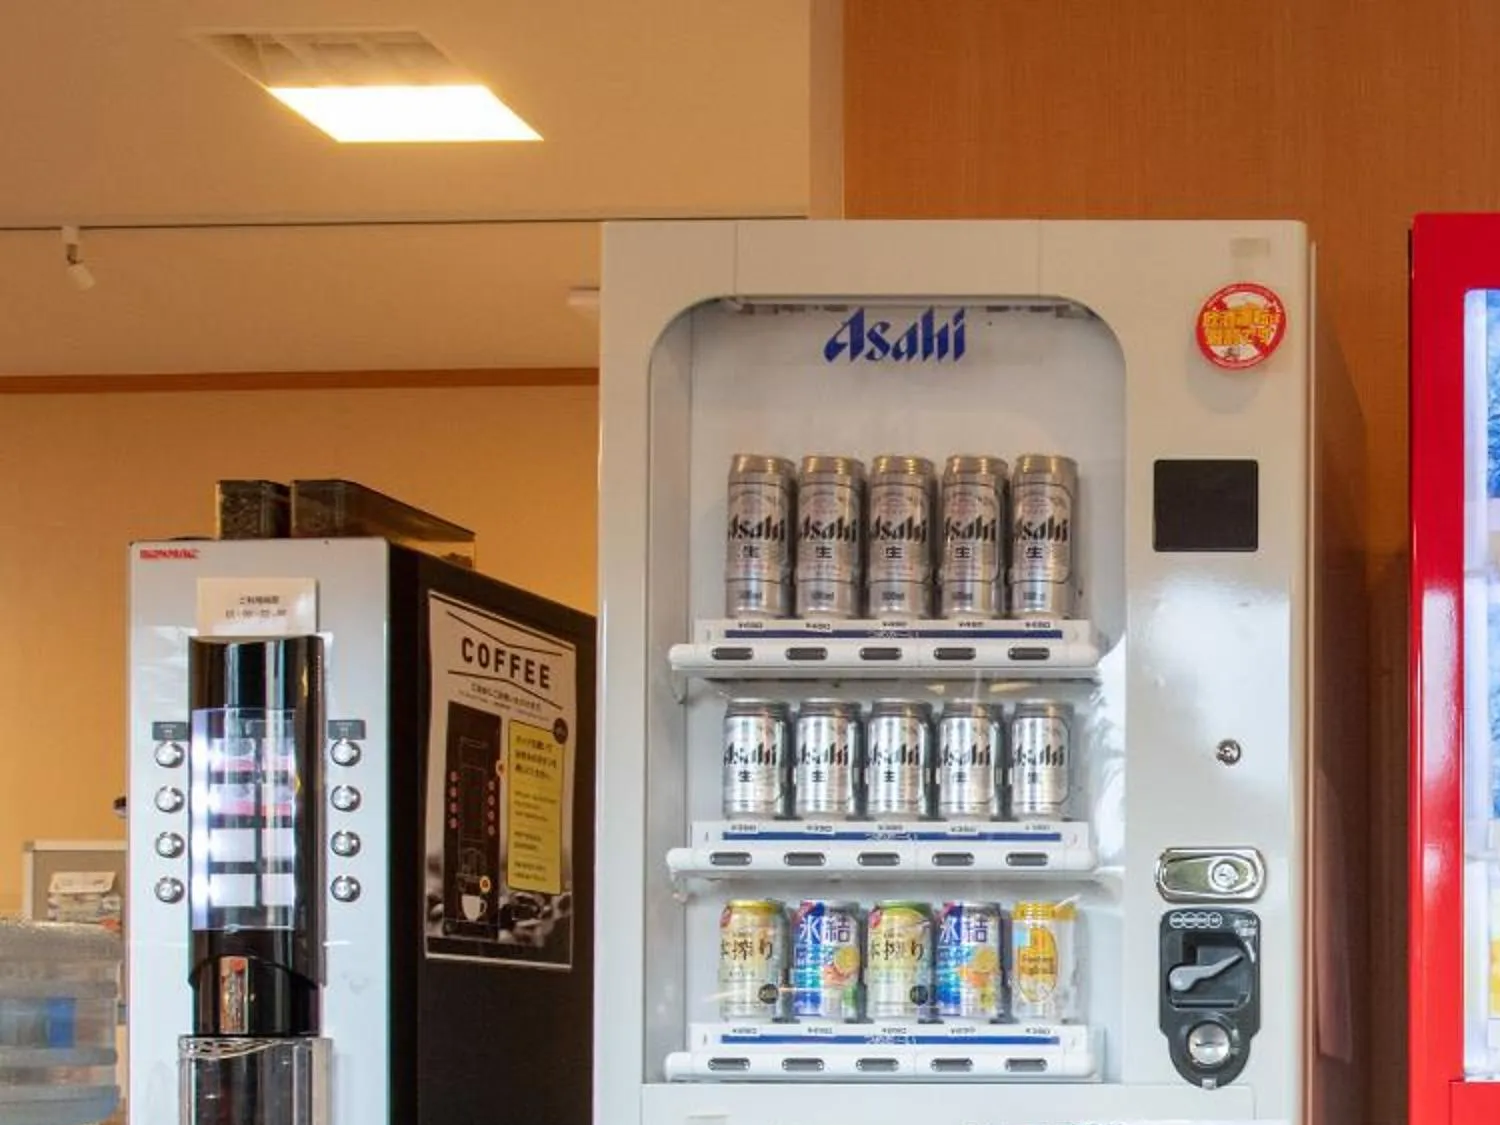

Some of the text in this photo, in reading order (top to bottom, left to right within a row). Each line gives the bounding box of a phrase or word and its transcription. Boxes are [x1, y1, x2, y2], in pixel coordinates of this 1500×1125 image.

[823, 307, 968, 364] Asahi
[461, 637, 551, 689] COFFEE
[800, 913, 850, 943] 氷結
[940, 914, 988, 943] 氷結
